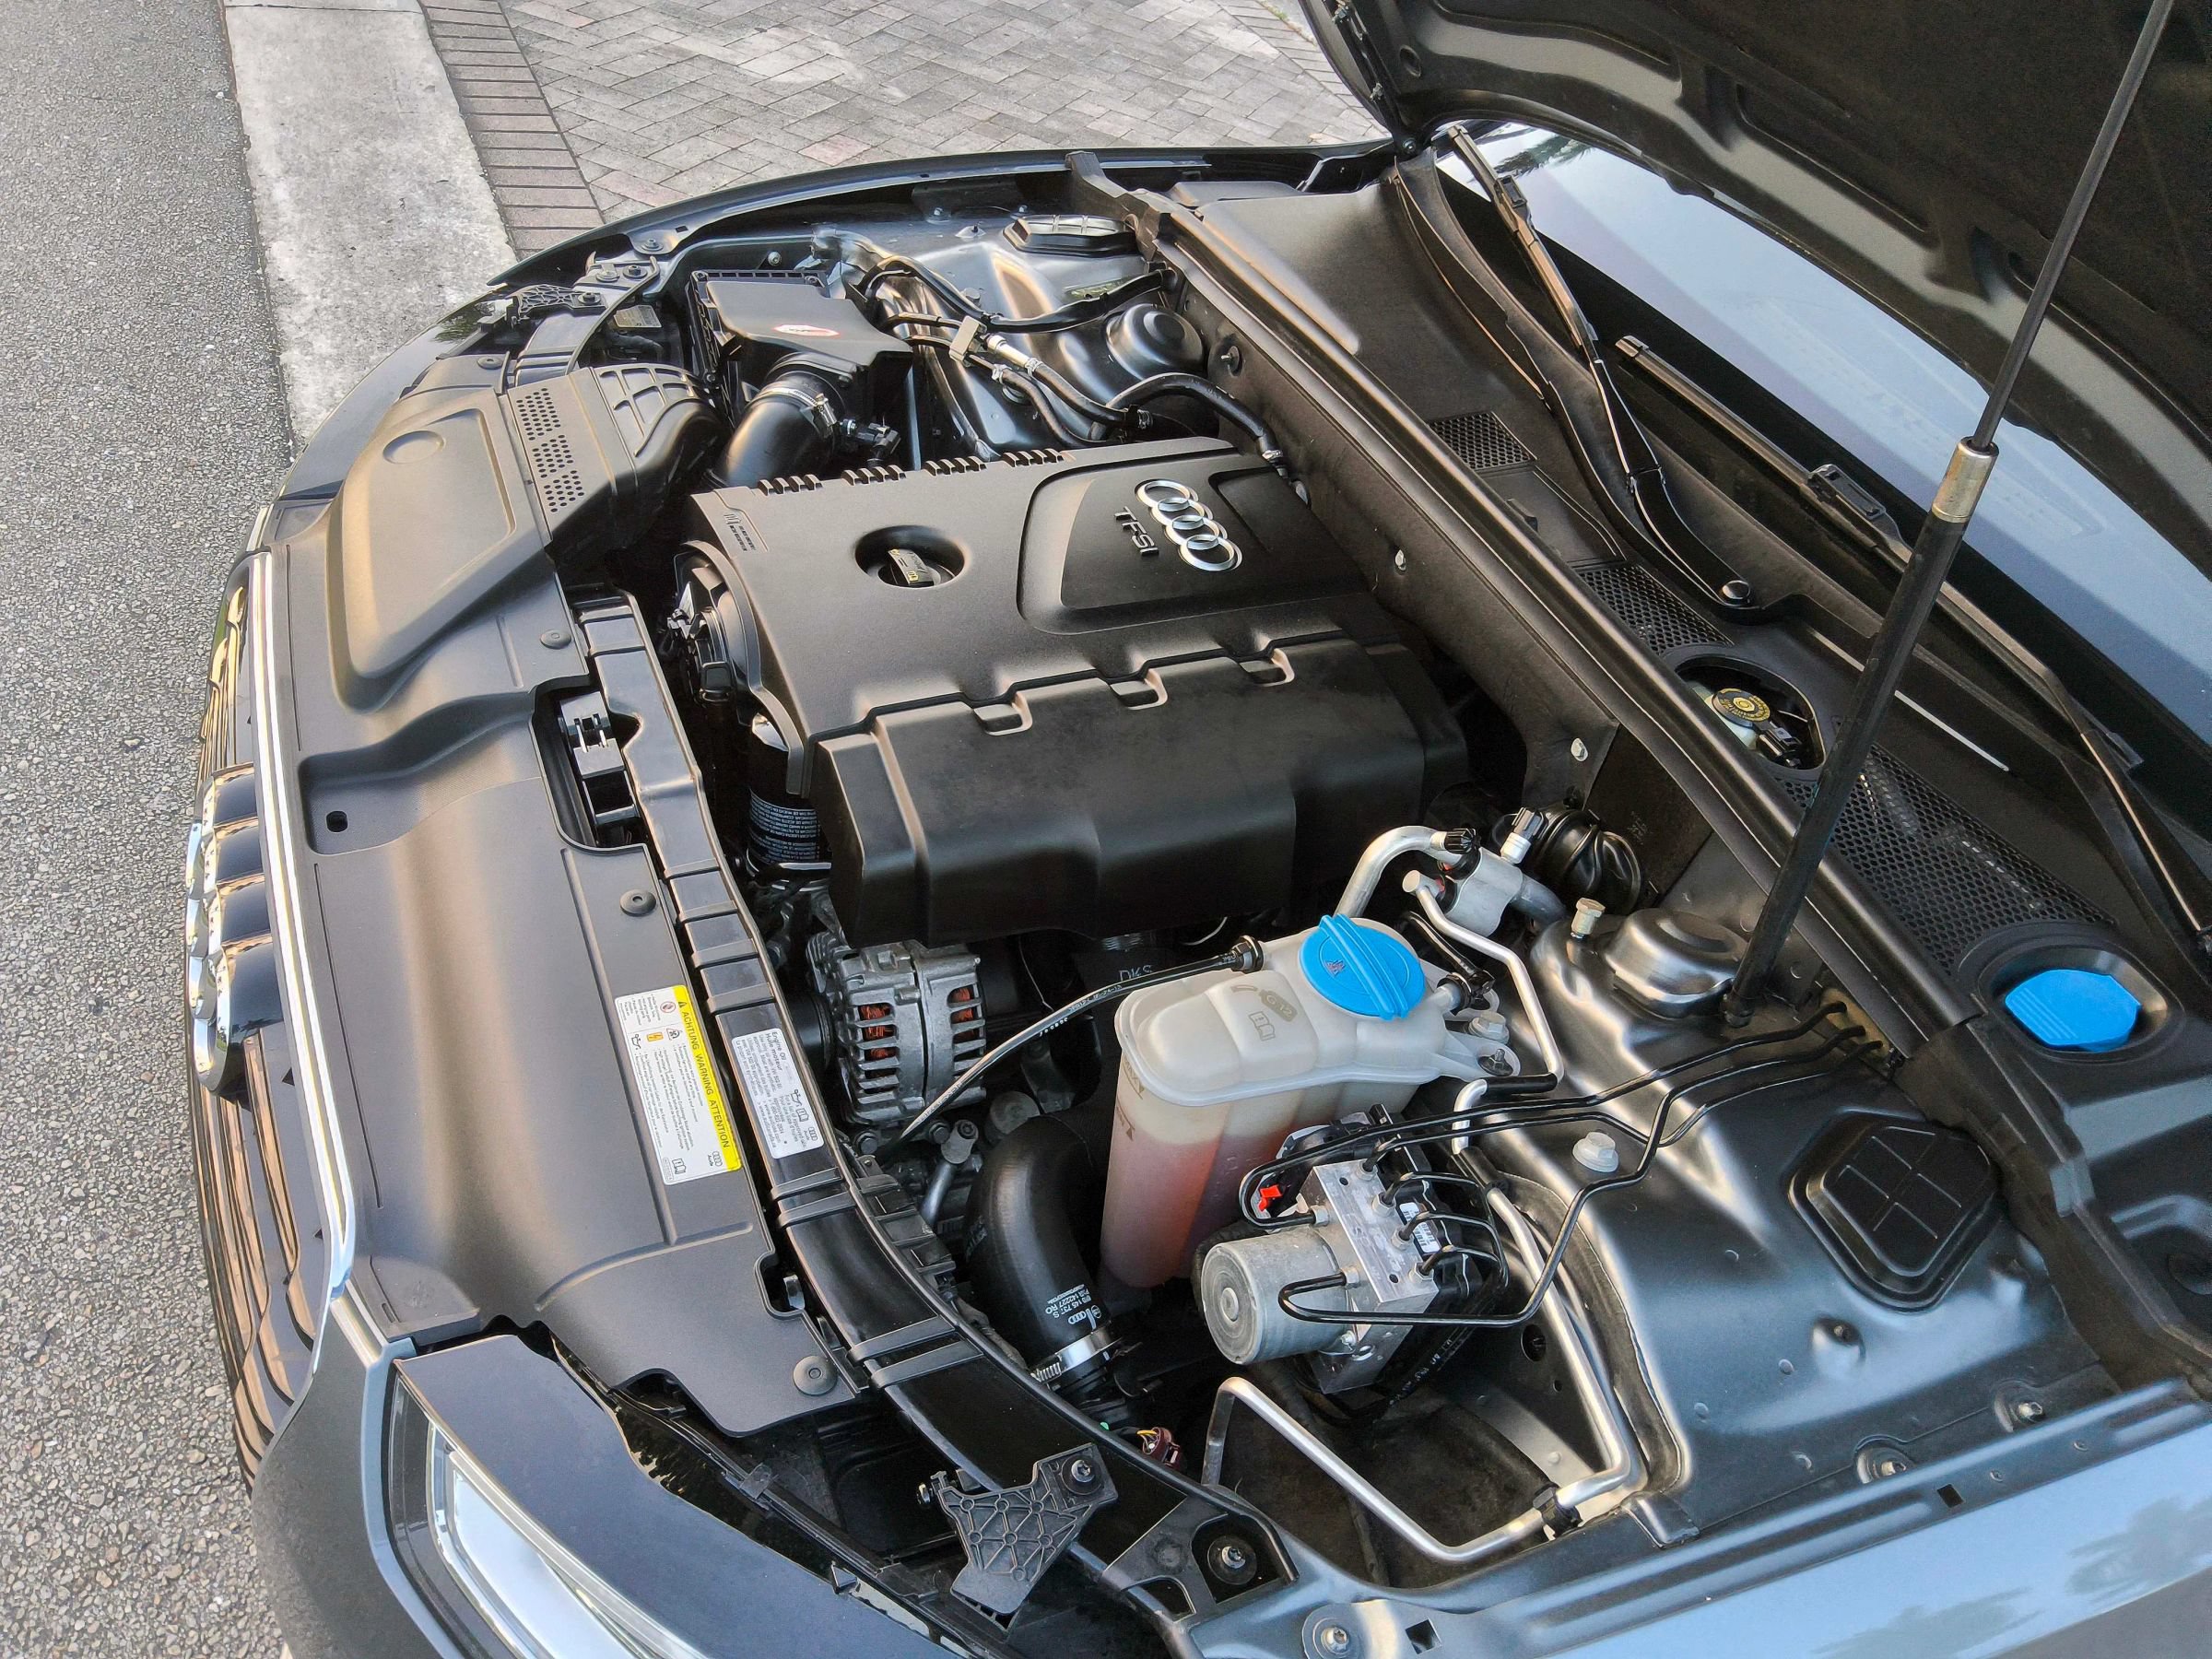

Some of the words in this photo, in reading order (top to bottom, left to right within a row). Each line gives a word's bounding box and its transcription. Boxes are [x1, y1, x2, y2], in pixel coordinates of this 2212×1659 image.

[1114, 506, 1159, 554] TFSI
[765, 1032, 774, 1047] Huile
[771, 1049, 782, 1071] moteur
[770, 1030, 783, 1051] Engine
[779, 1052, 787, 1060] Oil
[682, 1011, 699, 1049] ACHTUNG
[696, 1053, 712, 1094] WARNING
[710, 1099, 729, 1147] ATTENTION
